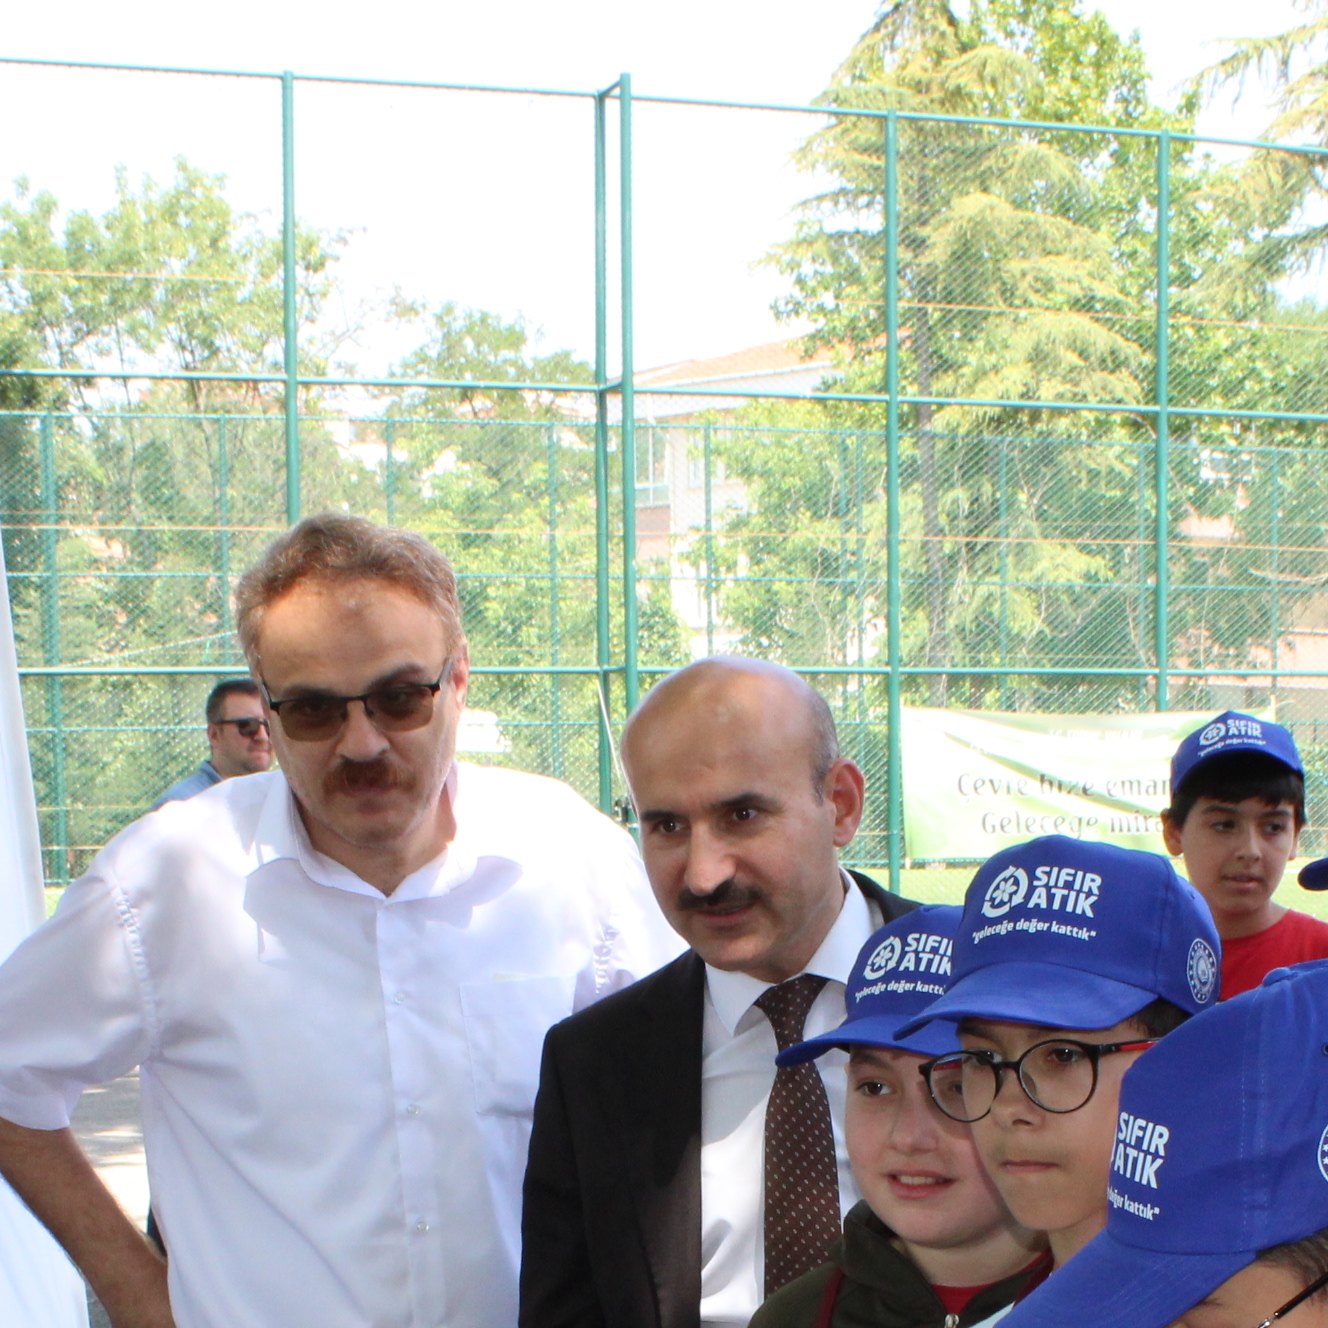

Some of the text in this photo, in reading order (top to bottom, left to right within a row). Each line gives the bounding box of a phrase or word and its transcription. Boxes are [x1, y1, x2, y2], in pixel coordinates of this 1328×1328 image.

[958, 773, 1029, 804] Çevre
[1039, 773, 1095, 798] bize
[982, 811, 1099, 839] Geleceğe
[1033, 865, 1102, 896] SIFIR
[1027, 886, 1099, 918] ATIK
[1015, 918, 1050, 933] değer
[886, 980, 916, 994] değer
[1118, 1111, 1170, 1157] SIFIR
[1114, 1143, 1164, 1189] ATIK
